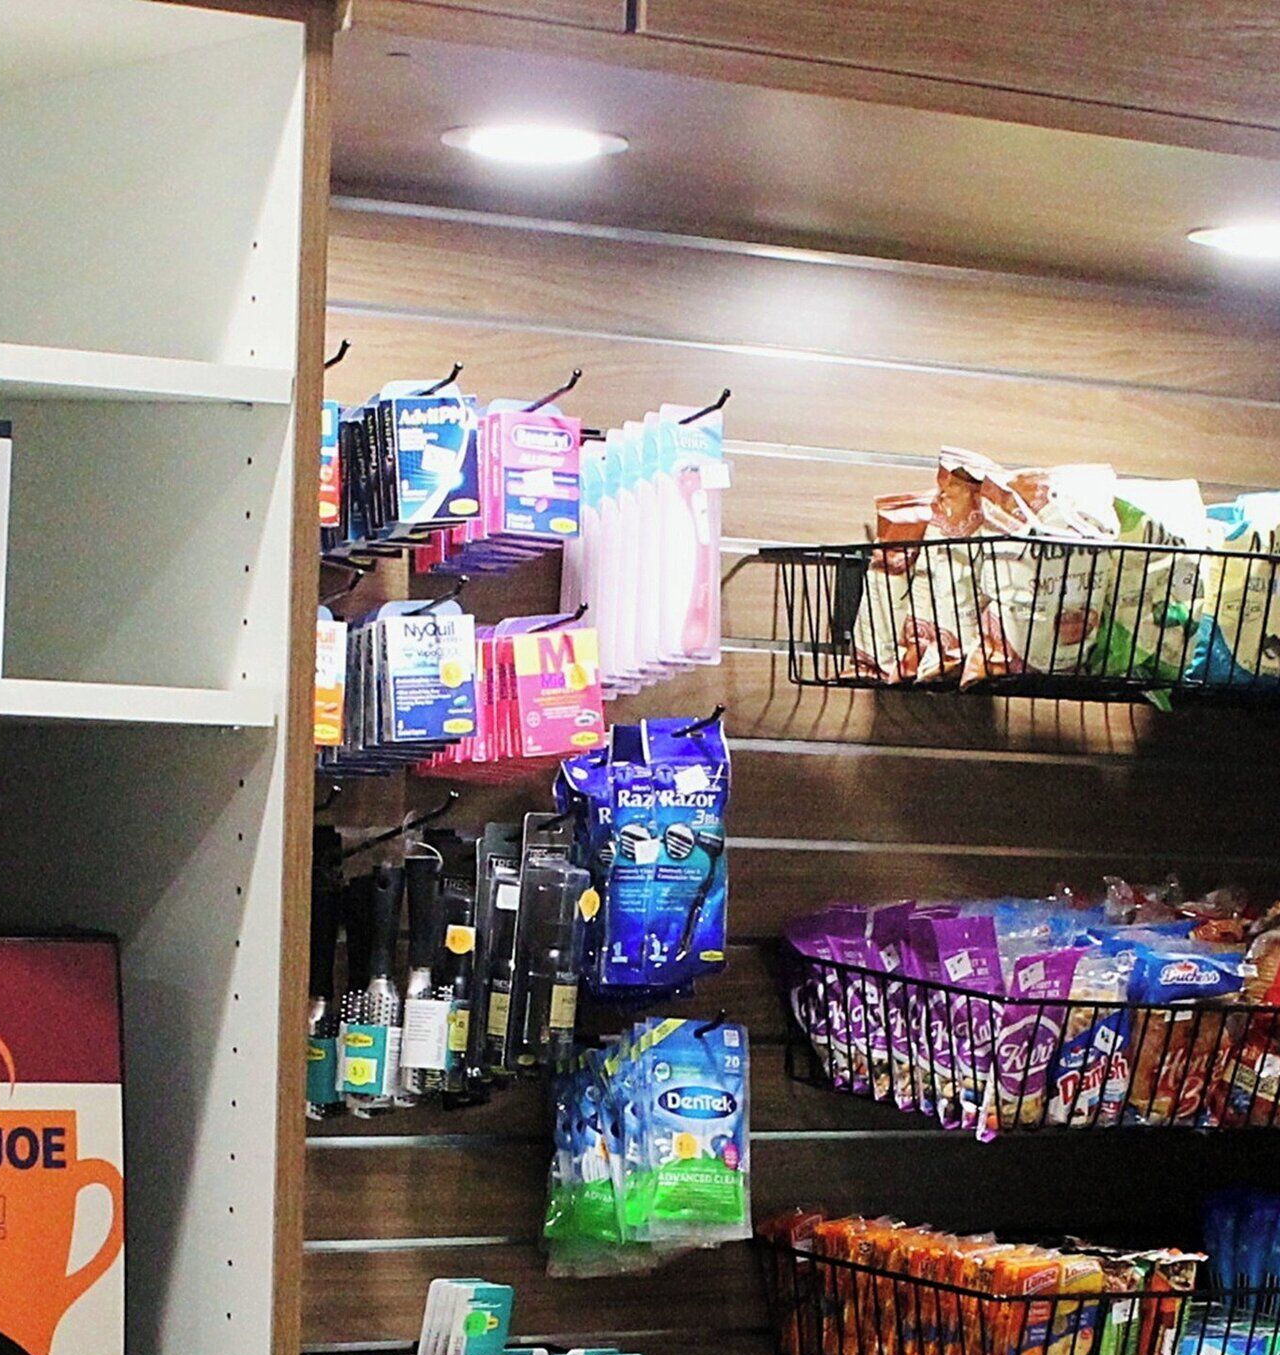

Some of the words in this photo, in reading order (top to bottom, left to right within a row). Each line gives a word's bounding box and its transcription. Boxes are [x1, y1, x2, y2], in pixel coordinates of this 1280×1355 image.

[404, 621, 455, 643] NyQuil
[660, 789, 716, 808] Razor
[724, 1056, 740, 1068] 20
[667, 1091, 733, 1113] DenTek
